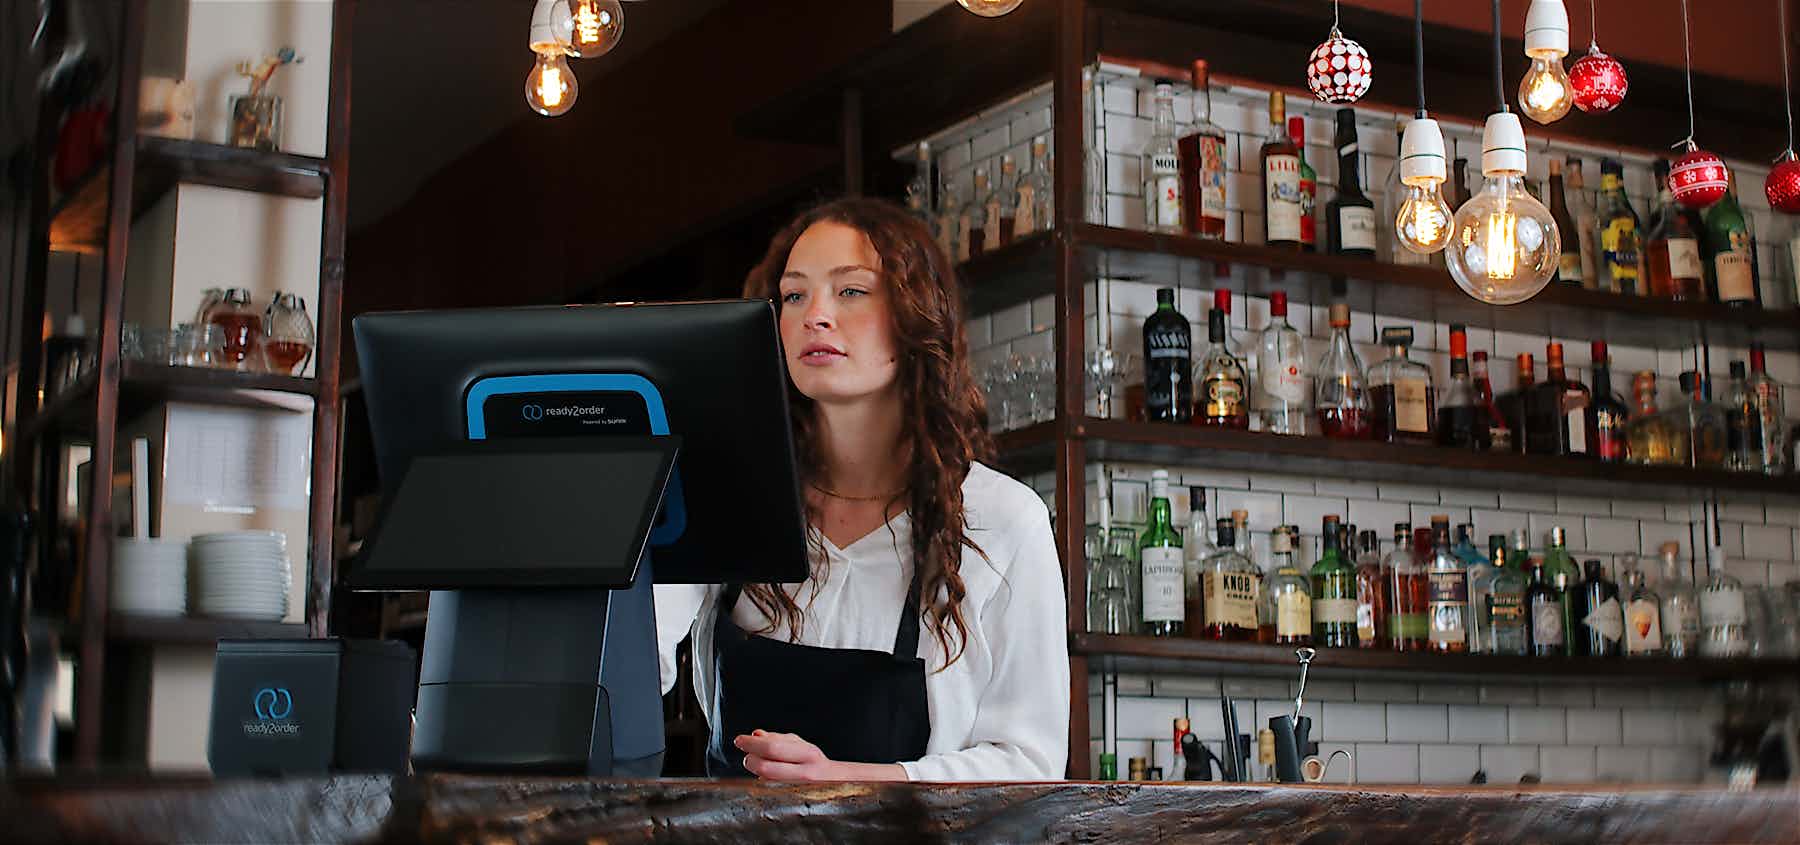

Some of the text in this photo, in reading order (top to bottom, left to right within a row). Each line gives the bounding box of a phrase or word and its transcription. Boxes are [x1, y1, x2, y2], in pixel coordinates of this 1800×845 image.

[545, 405, 605, 417] ready2order
[1223, 574, 1250, 593] KNOB
[243, 723, 299, 735] ready2order
